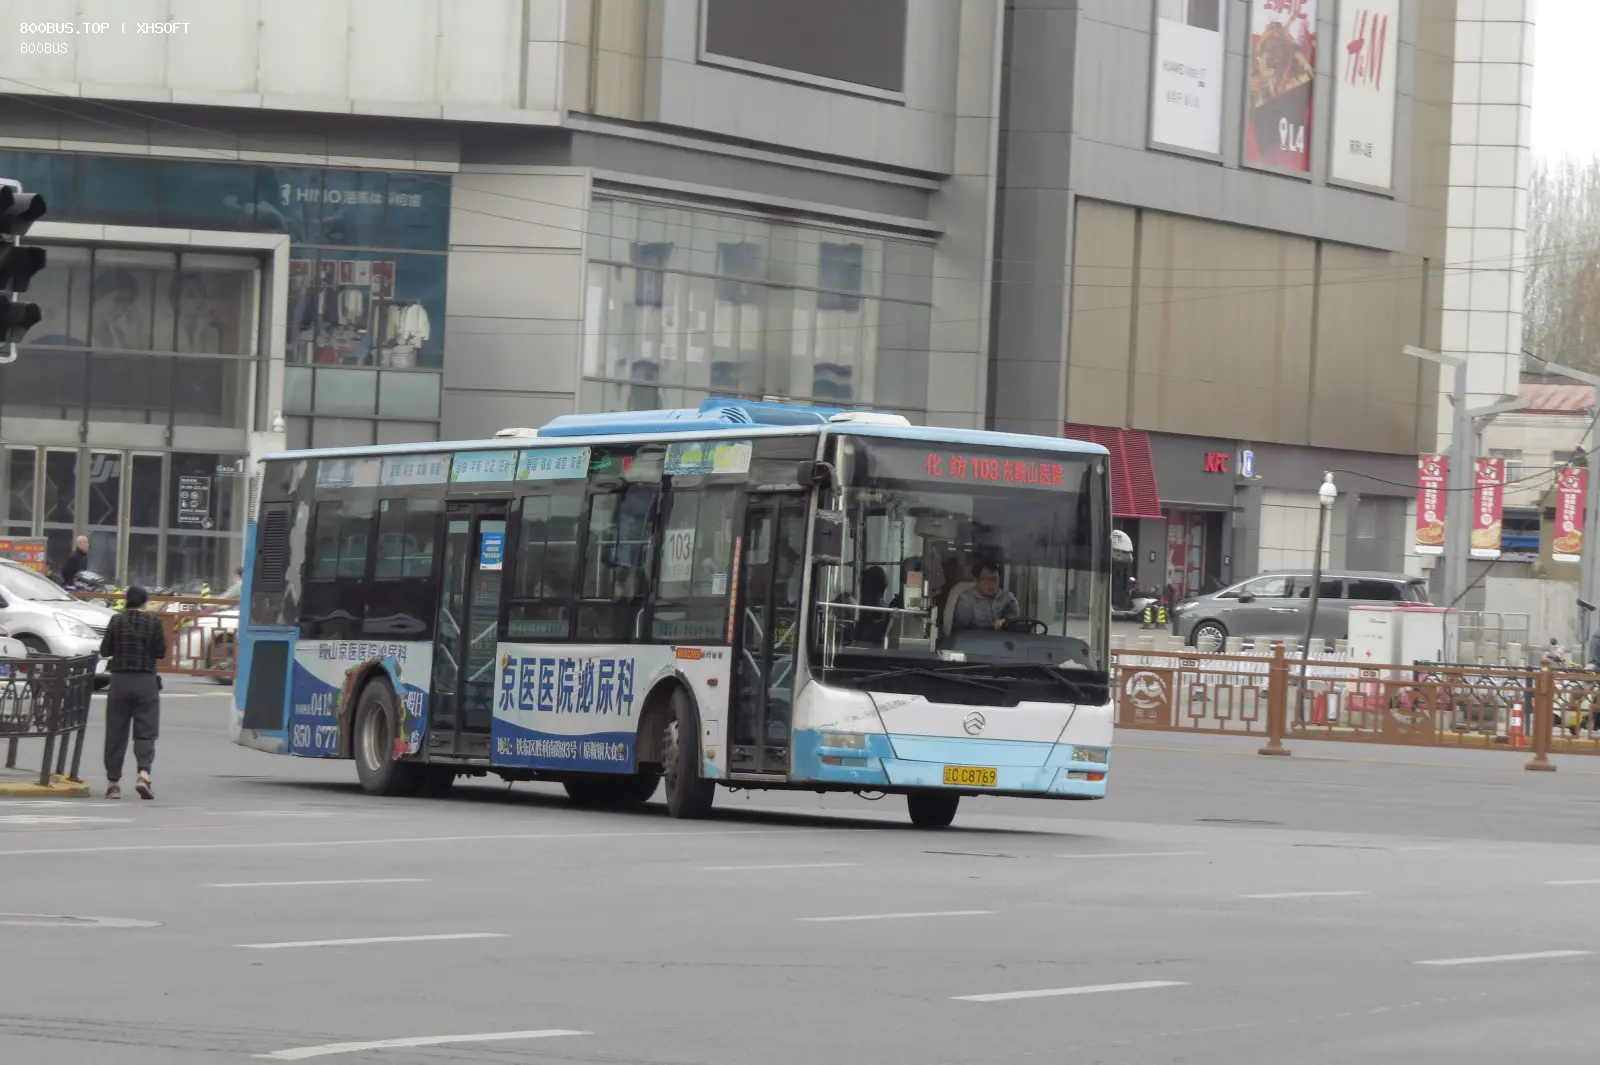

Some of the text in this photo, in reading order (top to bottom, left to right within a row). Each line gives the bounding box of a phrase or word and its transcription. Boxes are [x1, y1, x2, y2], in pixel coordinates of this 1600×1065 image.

[971, 458, 999, 481] 103
[669, 533, 691, 561] 103
[498, 656, 636, 717] 京医医院泌尿科
